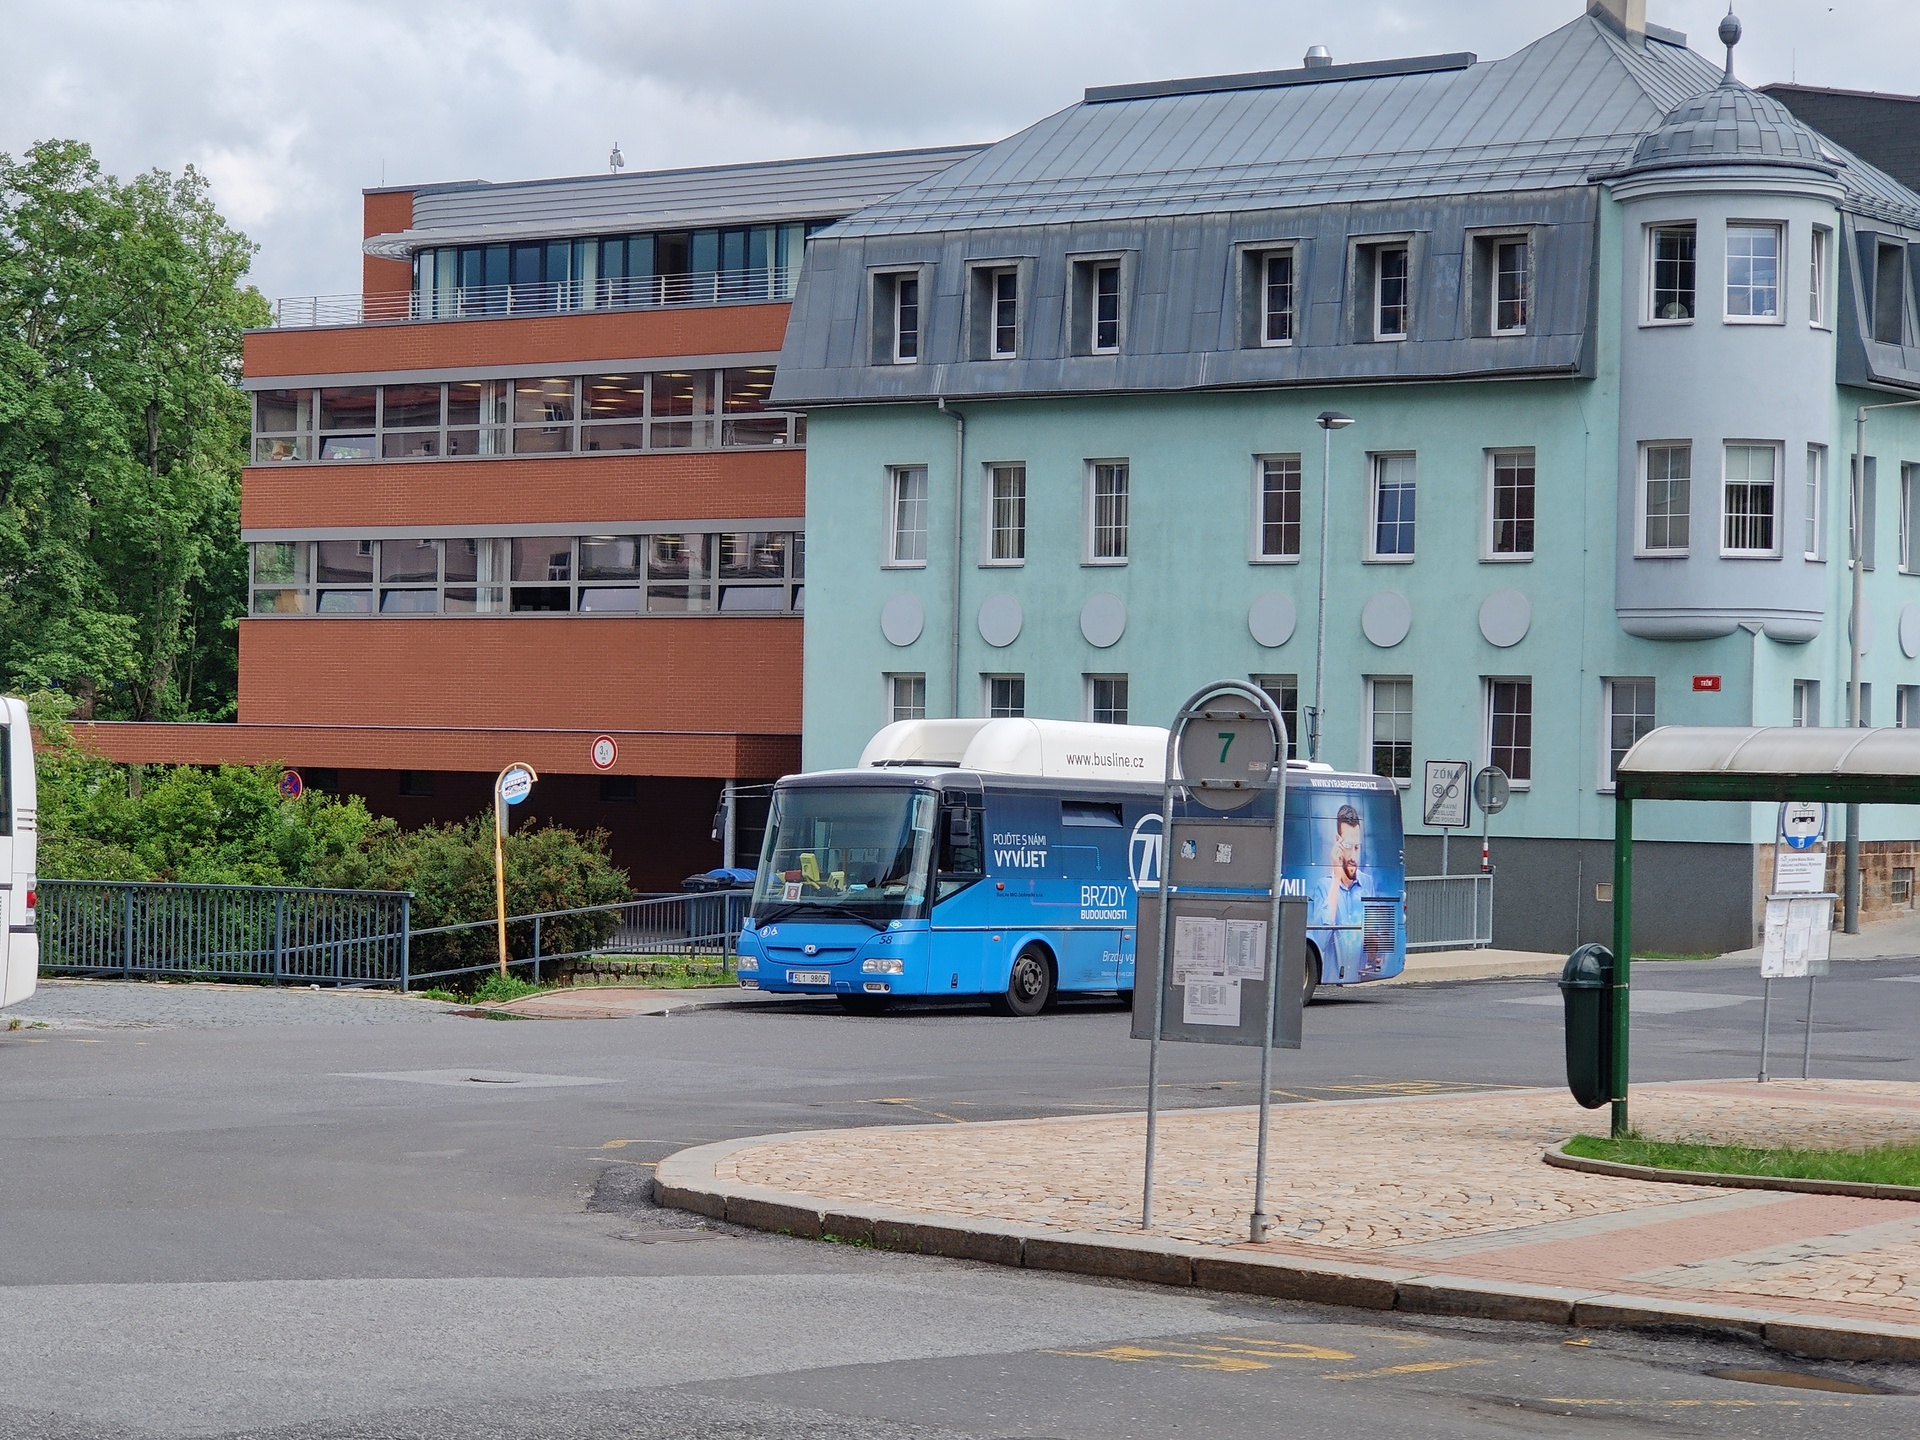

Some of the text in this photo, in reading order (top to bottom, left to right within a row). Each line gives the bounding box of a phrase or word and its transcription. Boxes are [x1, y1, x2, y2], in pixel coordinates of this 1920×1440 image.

[1217, 732, 1235, 763] 7
[1066, 752, 1145, 768] www.busline.cz
[1432, 768, 1460, 780] ZÓNA
[1434, 786, 1443, 795] 30
[993, 832, 1047, 846] POJĎTE S NÁMI
[994, 846, 1047, 868] VYVÍJET
[1081, 886, 1127, 907] BRZDY
[1081, 910, 1127, 920] BUDOUCNOSTI
[879, 935, 893, 945] 58
[1102, 950, 1135, 964] Brzdy vy
[794, 974, 806, 983] 5L1
